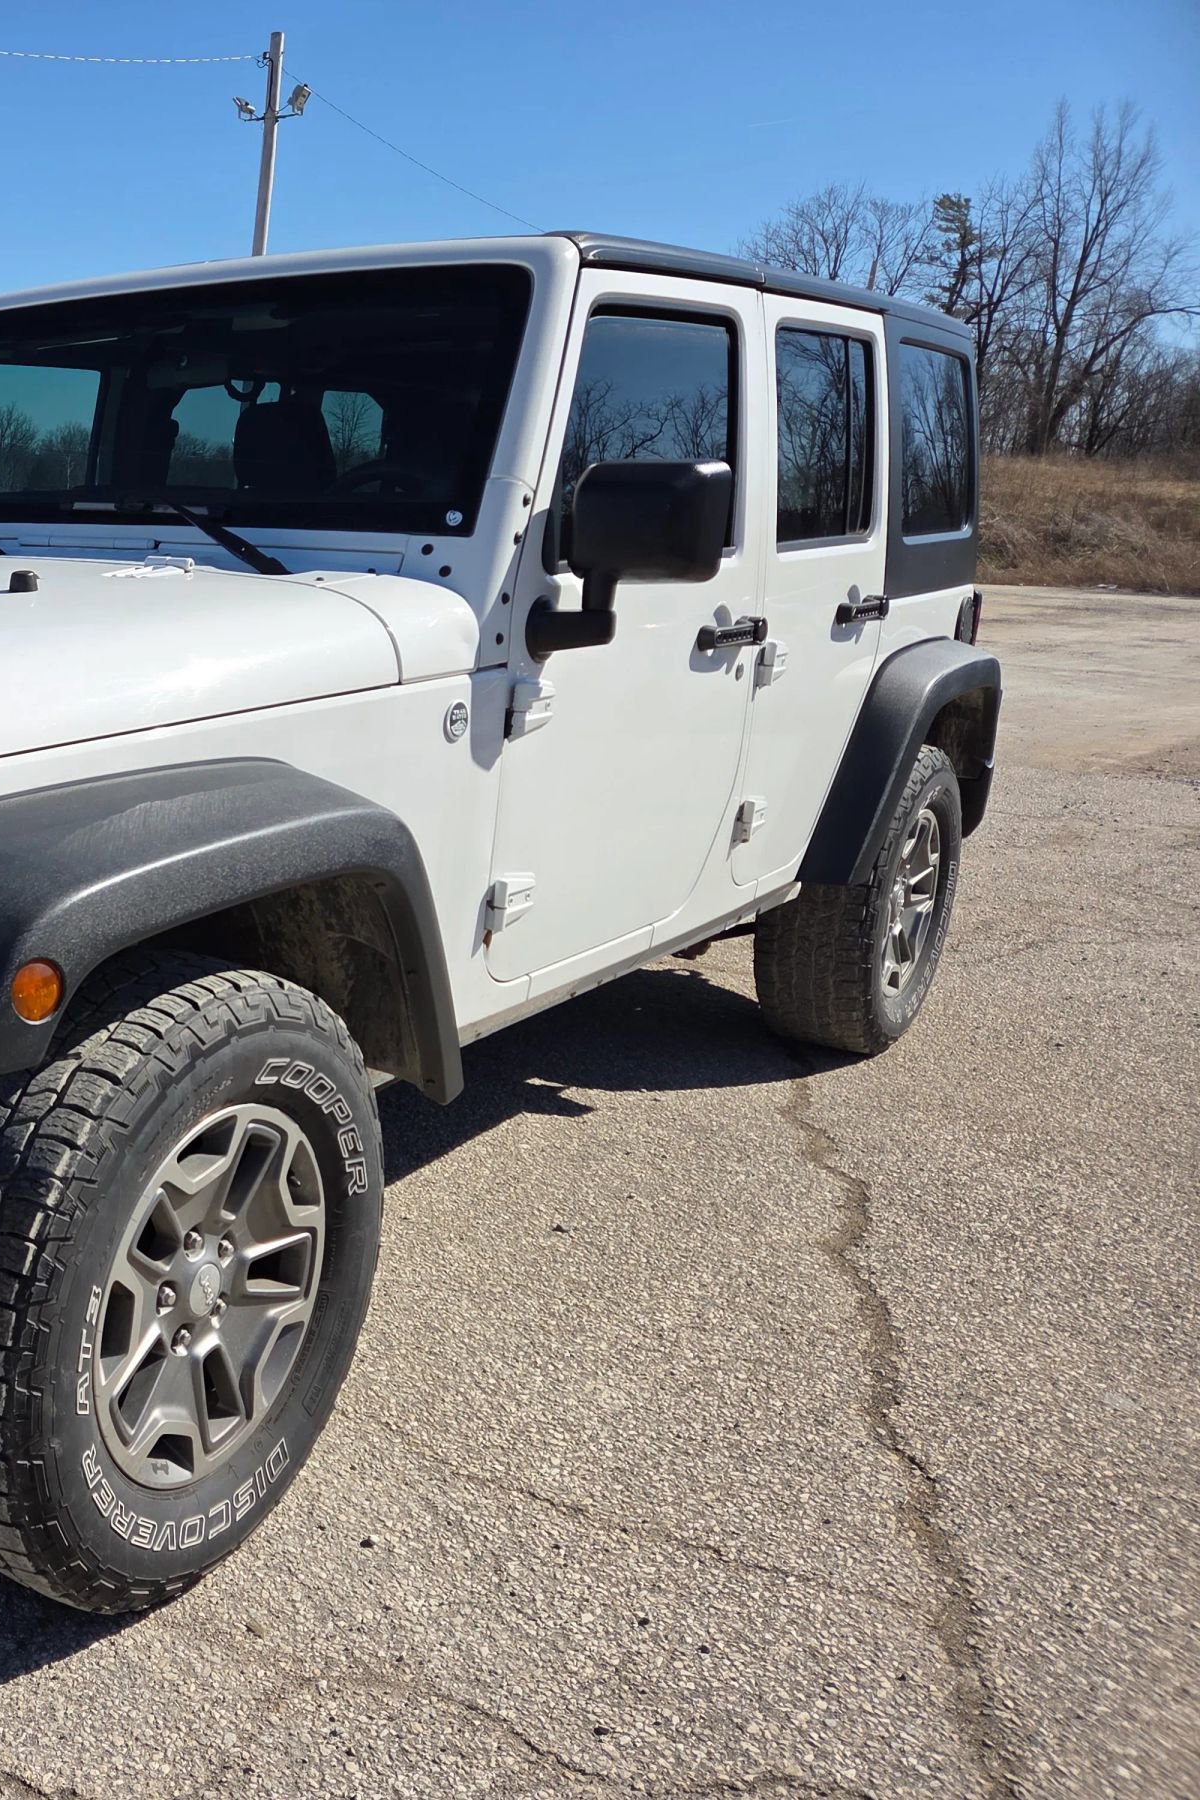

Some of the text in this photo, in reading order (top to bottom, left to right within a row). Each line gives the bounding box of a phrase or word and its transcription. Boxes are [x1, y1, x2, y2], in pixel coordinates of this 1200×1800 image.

[255, 1057, 369, 1197] COOPER
[76, 1285, 103, 1415] AT3
[81, 1437, 291, 1551] DISCOVERER
